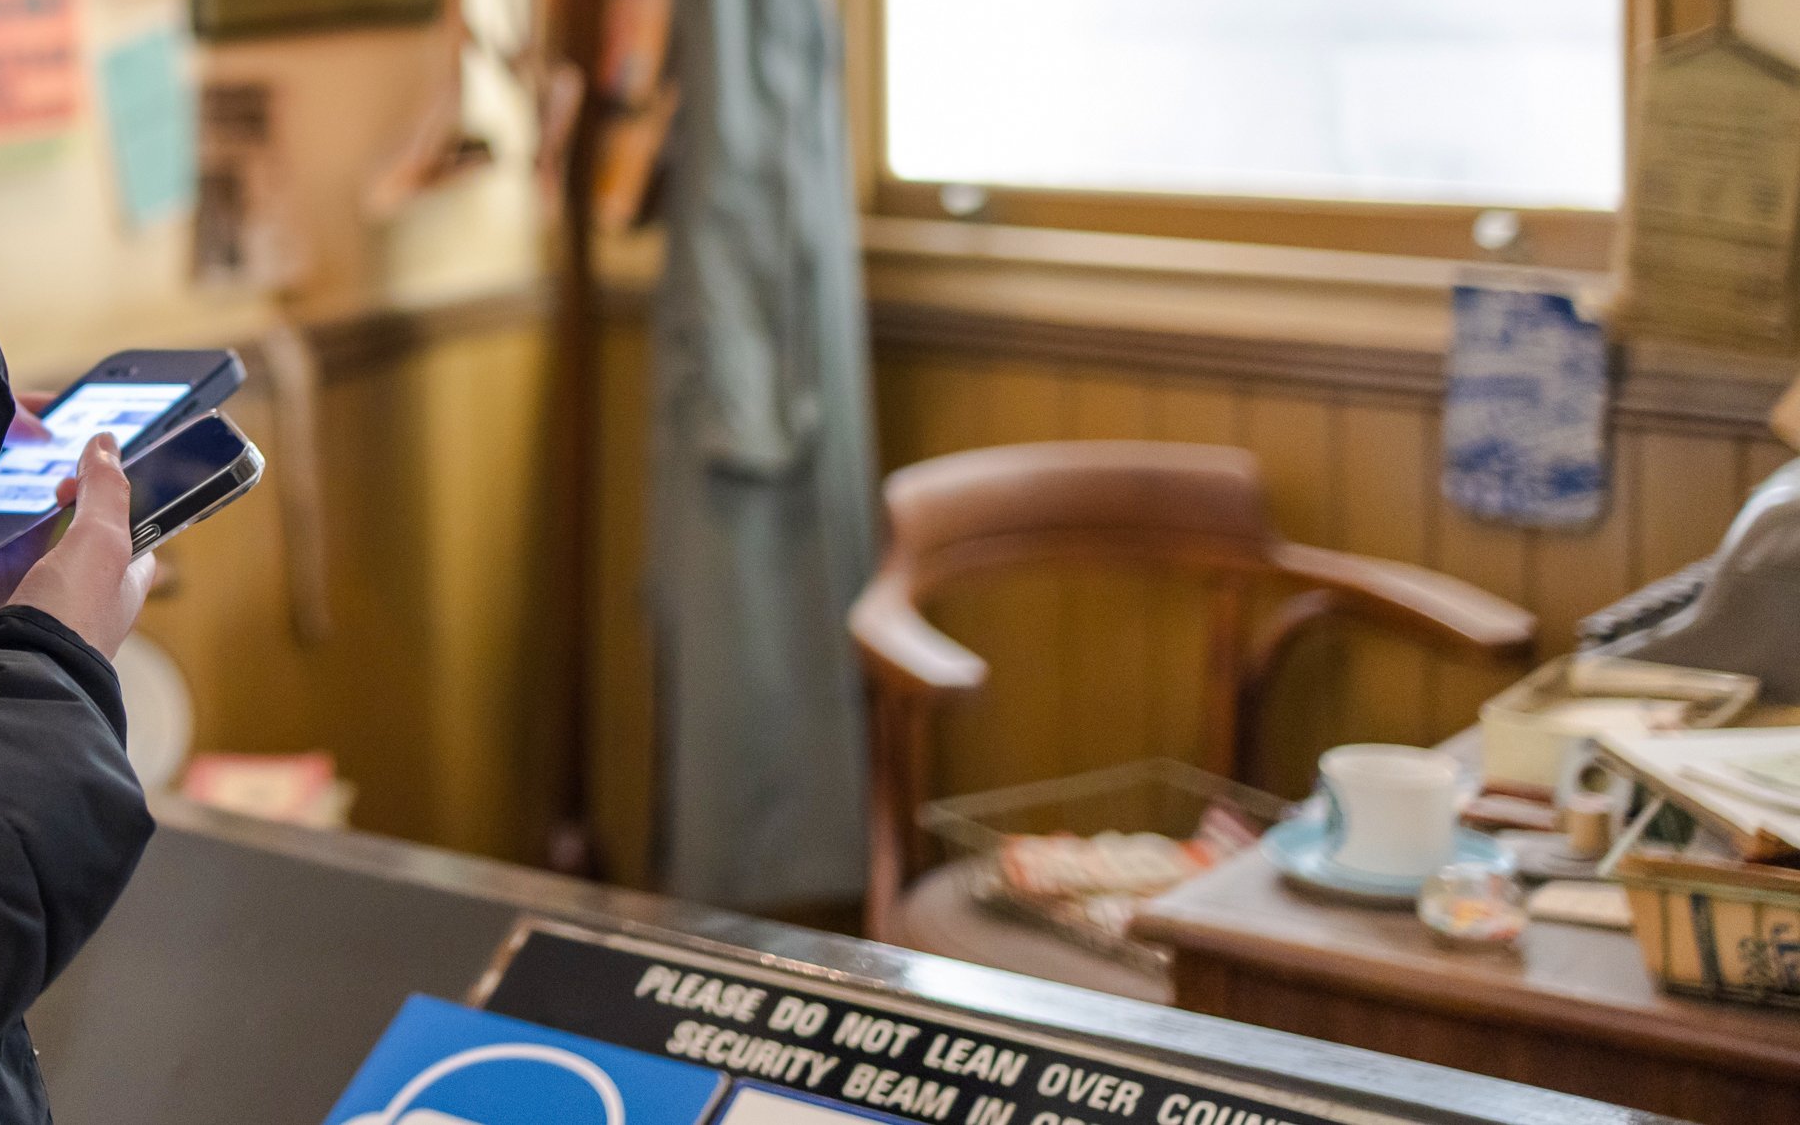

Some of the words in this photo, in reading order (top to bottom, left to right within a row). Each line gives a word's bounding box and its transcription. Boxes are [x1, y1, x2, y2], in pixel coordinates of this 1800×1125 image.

[634, 964, 767, 1022] PLEASE
[767, 995, 829, 1038] DO
[832, 1012, 920, 1059] NOT
[923, 1033, 1029, 1087] LEAN
[1037, 1063, 1145, 1116] OVER
[665, 1020, 840, 1088] SECURITY
[841, 1062, 960, 1121] BEAM
[964, 1094, 1017, 1125] IN
